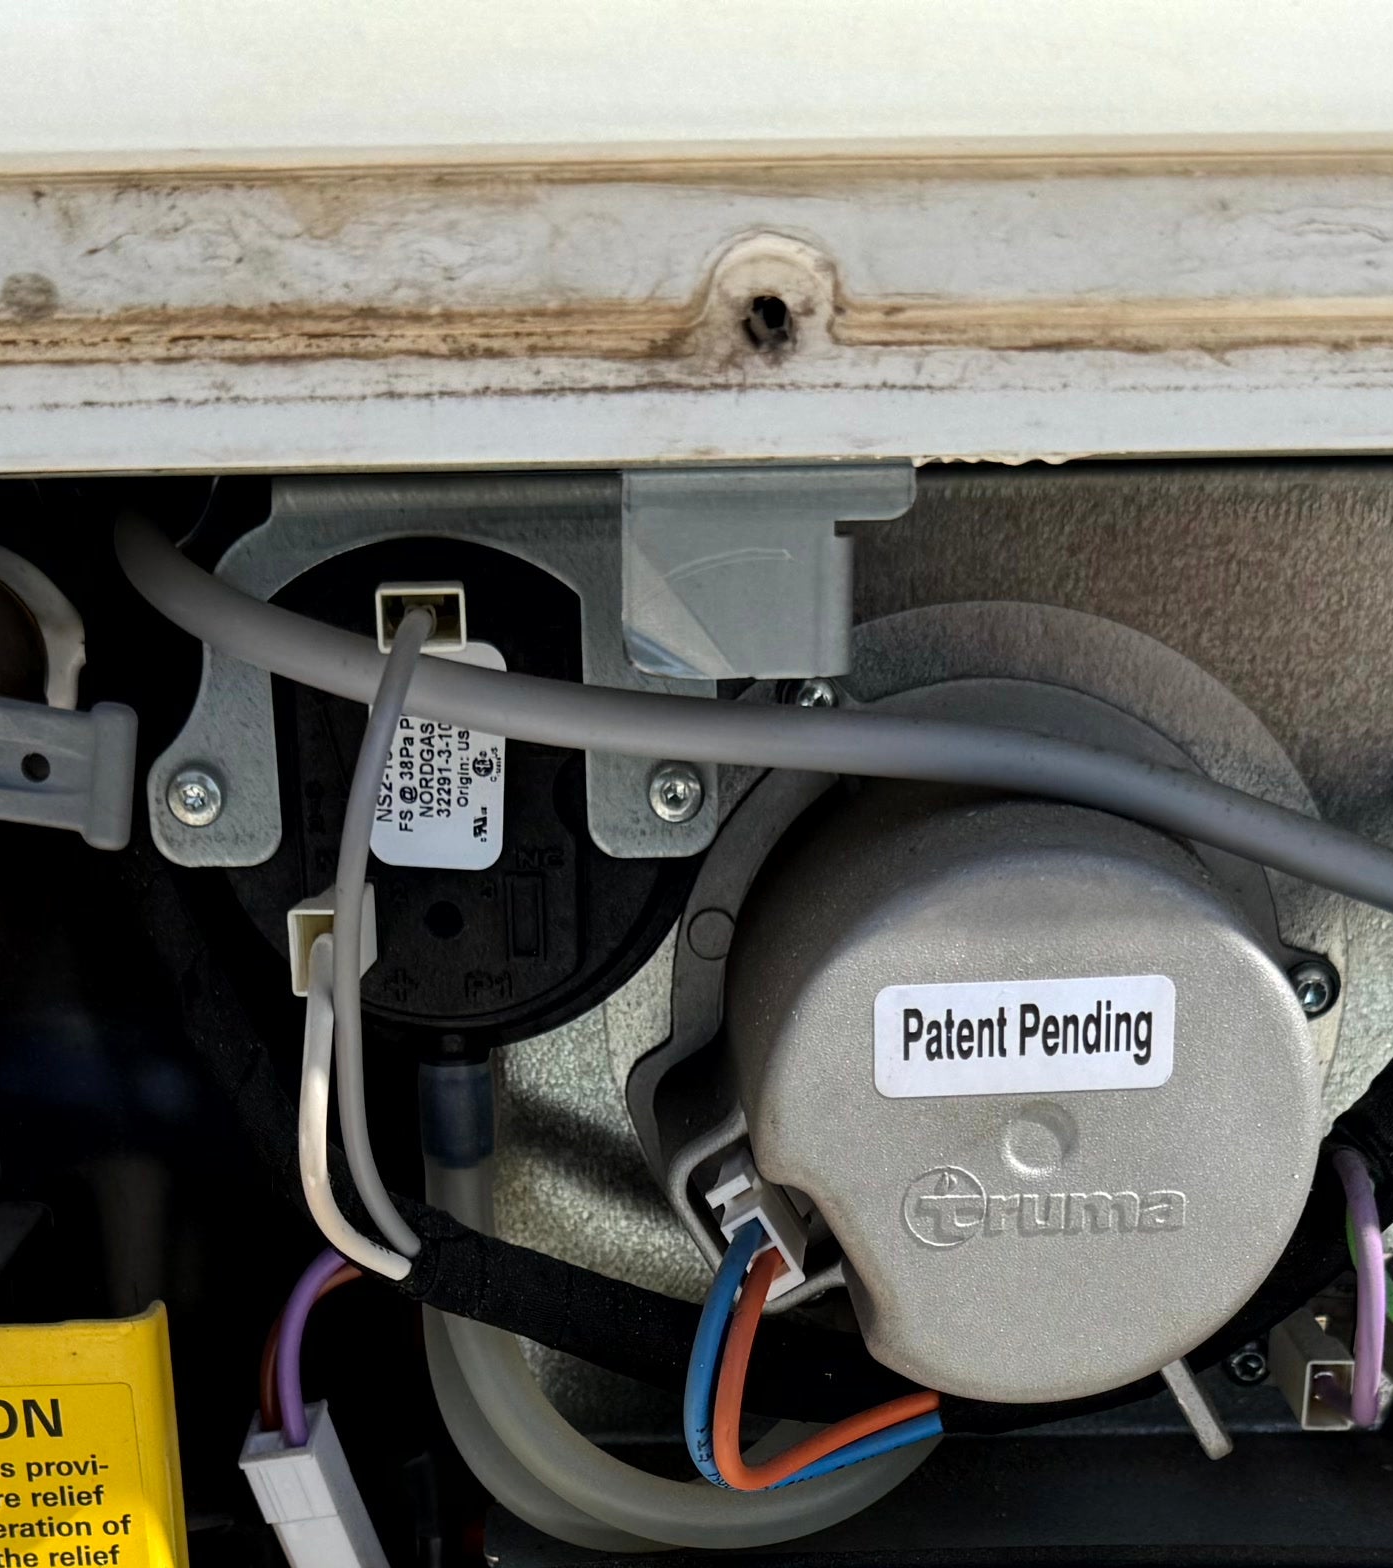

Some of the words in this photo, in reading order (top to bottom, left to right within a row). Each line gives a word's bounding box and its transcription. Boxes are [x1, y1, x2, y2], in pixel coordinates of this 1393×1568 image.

[399, 737, 414, 781] 38Pa
[419, 723, 434, 818] NORDGAS
[400, 786, 417, 803] @
[456, 757, 471, 807] Origin:
[399, 810, 413, 832] FS
[904, 1007, 1006, 1060] Patent
[1019, 1000, 1152, 1065] Pending
[905, 1166, 1185, 1246] truma
[26, 1454, 108, 1482] provi-
[32, 1485, 103, 1507] relief
[103, 1514, 131, 1535] of
[49, 1544, 119, 1567] relief
